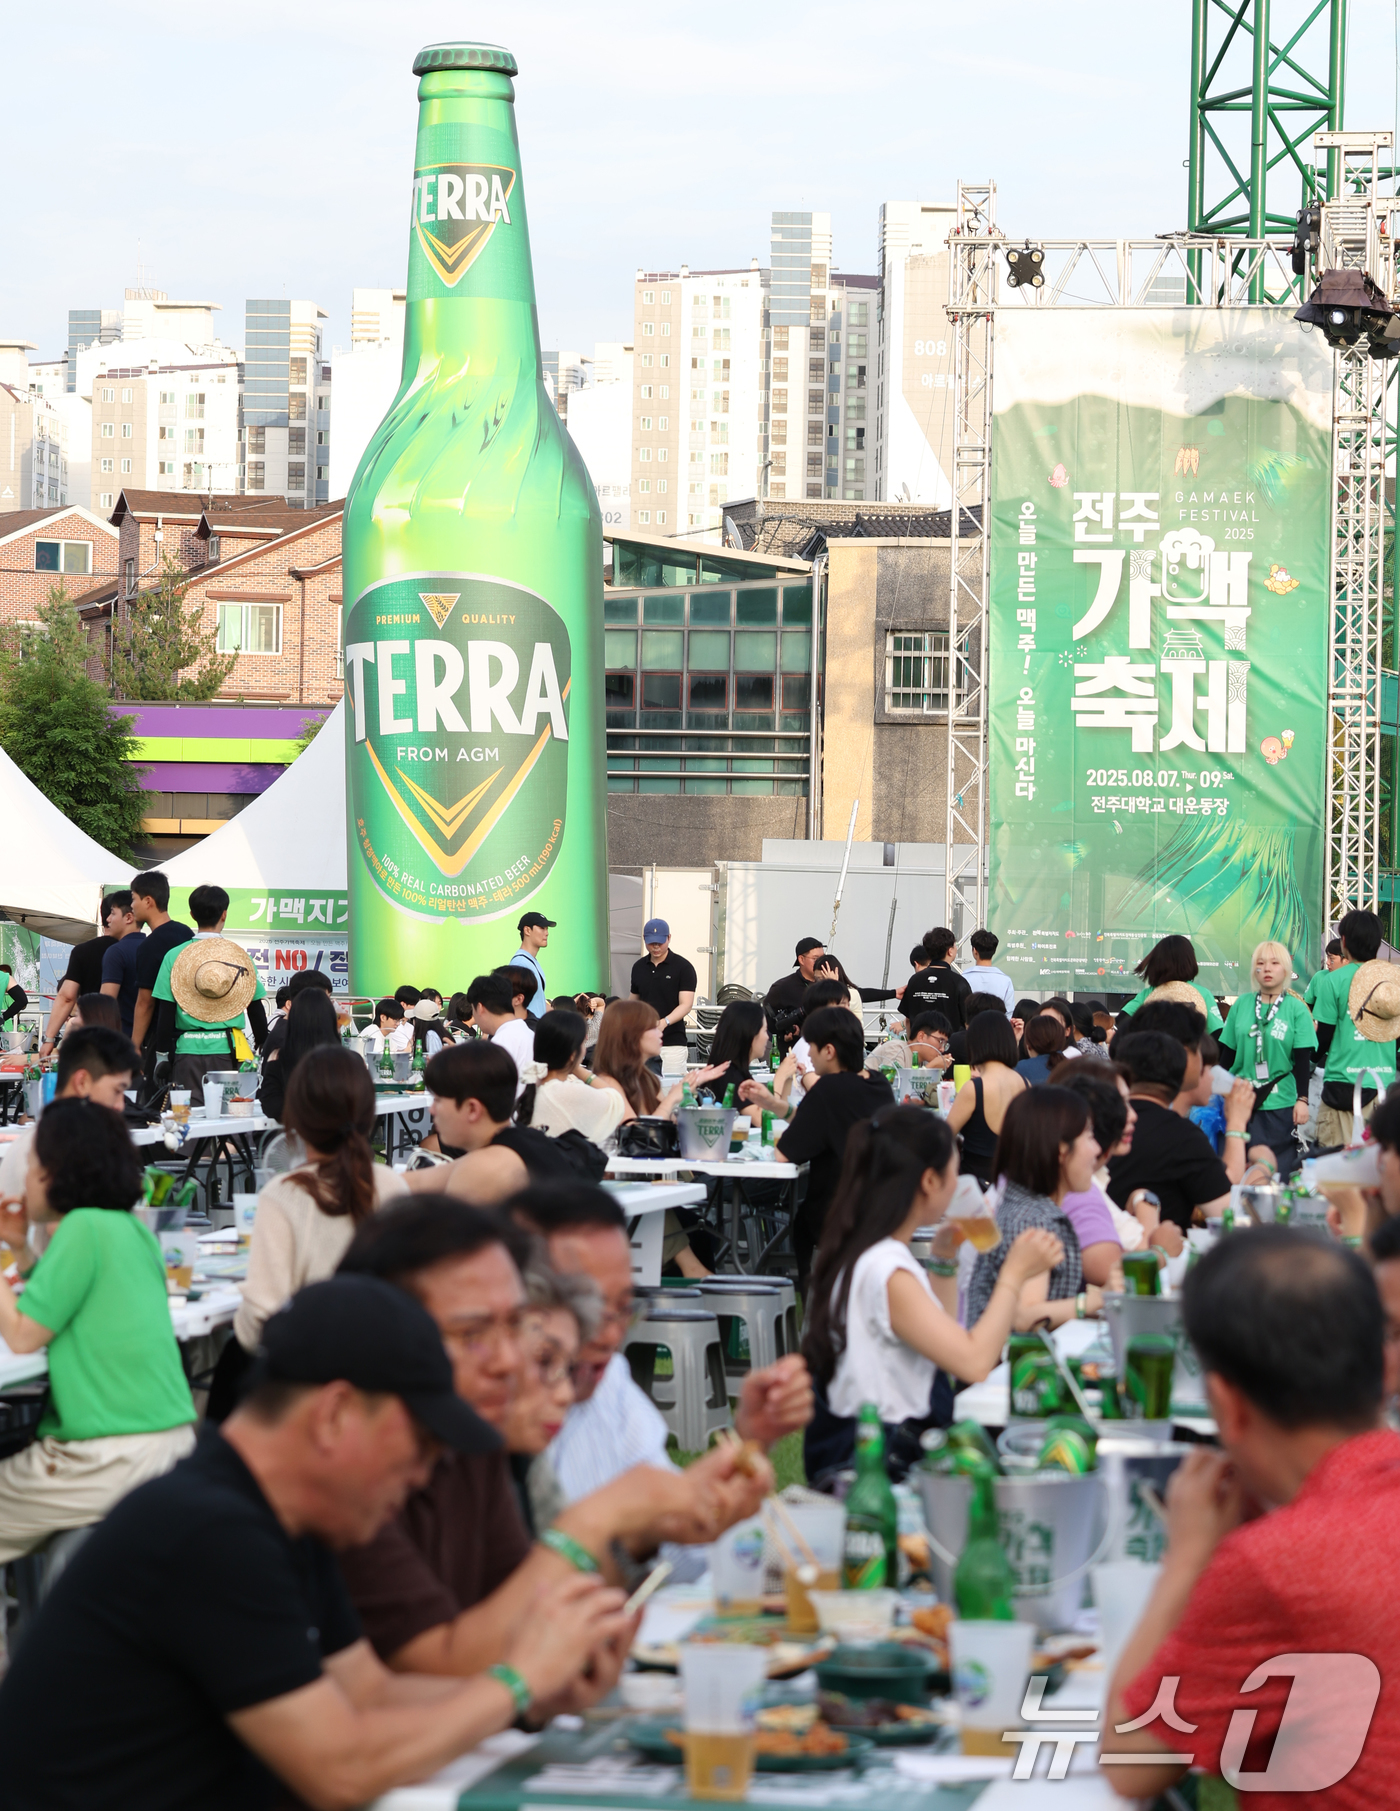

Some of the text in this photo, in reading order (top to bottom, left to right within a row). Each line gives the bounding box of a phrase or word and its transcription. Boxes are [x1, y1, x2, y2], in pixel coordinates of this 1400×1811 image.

[412, 174, 512, 229] TERRA
[914, 340, 947, 356] 808
[1175, 491, 1255, 504] GAMAEK
[1073, 492, 1160, 542] 전주
[1179, 509, 1260, 522] FESTIVAL
[1224, 528, 1255, 540] 2025
[1073, 543, 1253, 651] 가맥
[376, 613, 516, 625] PREMIUM QUALITY
[1015, 501, 1038, 801] 오늘 만든 맥주! 오늘 마신다
[345, 639, 569, 743] TERRA
[1071, 656, 1251, 753] 축제
[397, 746, 499, 762] FROM AGM
[1086, 769, 1180, 787] 2025.08.07.
[1181, 771, 1197, 779] Thur.
[1200, 771, 1224, 788] 09.
[1091, 796, 1230, 815] 전주대학교 대운동장
[381, 853, 531, 897] 100% REAL CARBONATED BEER
[386, 876, 402, 895] 만든
[402, 888, 426, 906] 100%
[428, 897, 466, 912] 리얼탄산
[511, 873, 531, 892] 500
[275, 949, 307, 971] NO
[697, 1125, 724, 1136] TERRA
